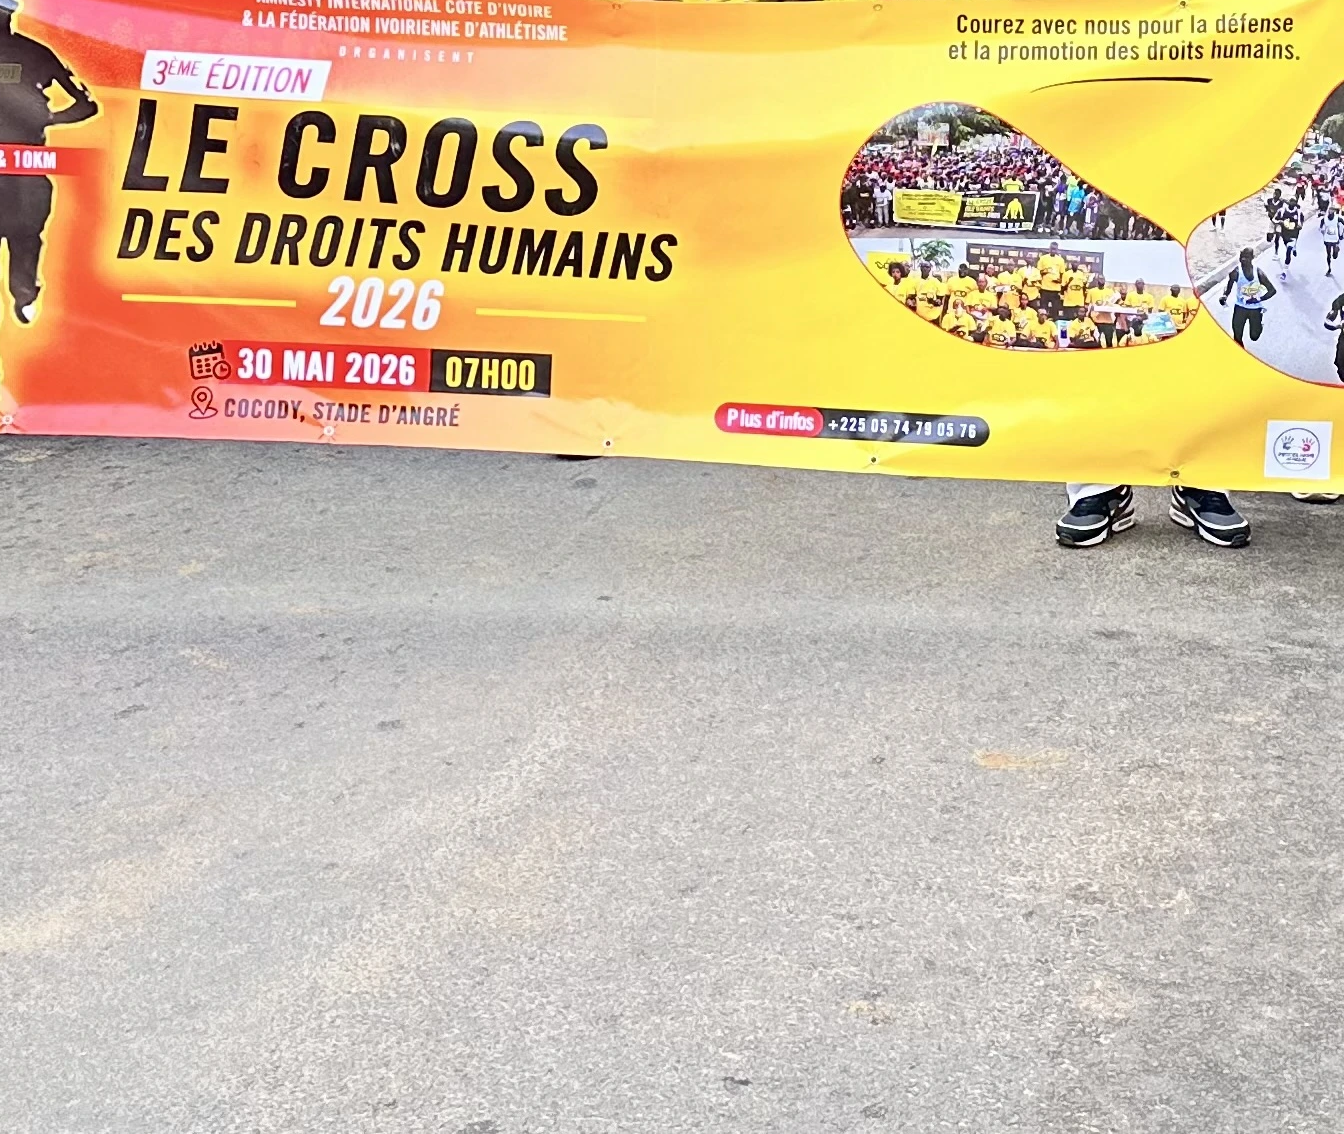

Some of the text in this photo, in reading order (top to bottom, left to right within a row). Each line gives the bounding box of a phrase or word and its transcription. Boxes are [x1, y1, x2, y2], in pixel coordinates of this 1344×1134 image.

[488, 0, 553, 19] D'IVOIRE
[242, 10, 568, 42] & LA FÉDÉRATION IVOIRIENNE D'ATHLÉTISME
[957, 12, 1294, 39] Courez avec nous pour la défense
[339, 45, 476, 64] ORGANISENT
[948, 38, 1301, 64] et la promotion des droits humains.
[153, 58, 313, 94] 3ÈME ÉDITION
[13, 150, 57, 169] 10KM
[121, 98, 609, 217] LE CROSS
[117, 207, 679, 282] DES DROITS HUMAINS
[320, 275, 446, 331] 2026
[237, 347, 537, 391] 30 MAI 2026 07H00
[224, 398, 461, 428] COCODY, STADE D'ANGRÉ
[766, 411, 815, 432] d'infos
[828, 416, 866, 433] +225
[871, 418, 888, 433] 05
[893, 419, 910, 435] 74
[937, 422, 954, 438] 05
[959, 423, 977, 439] 76
